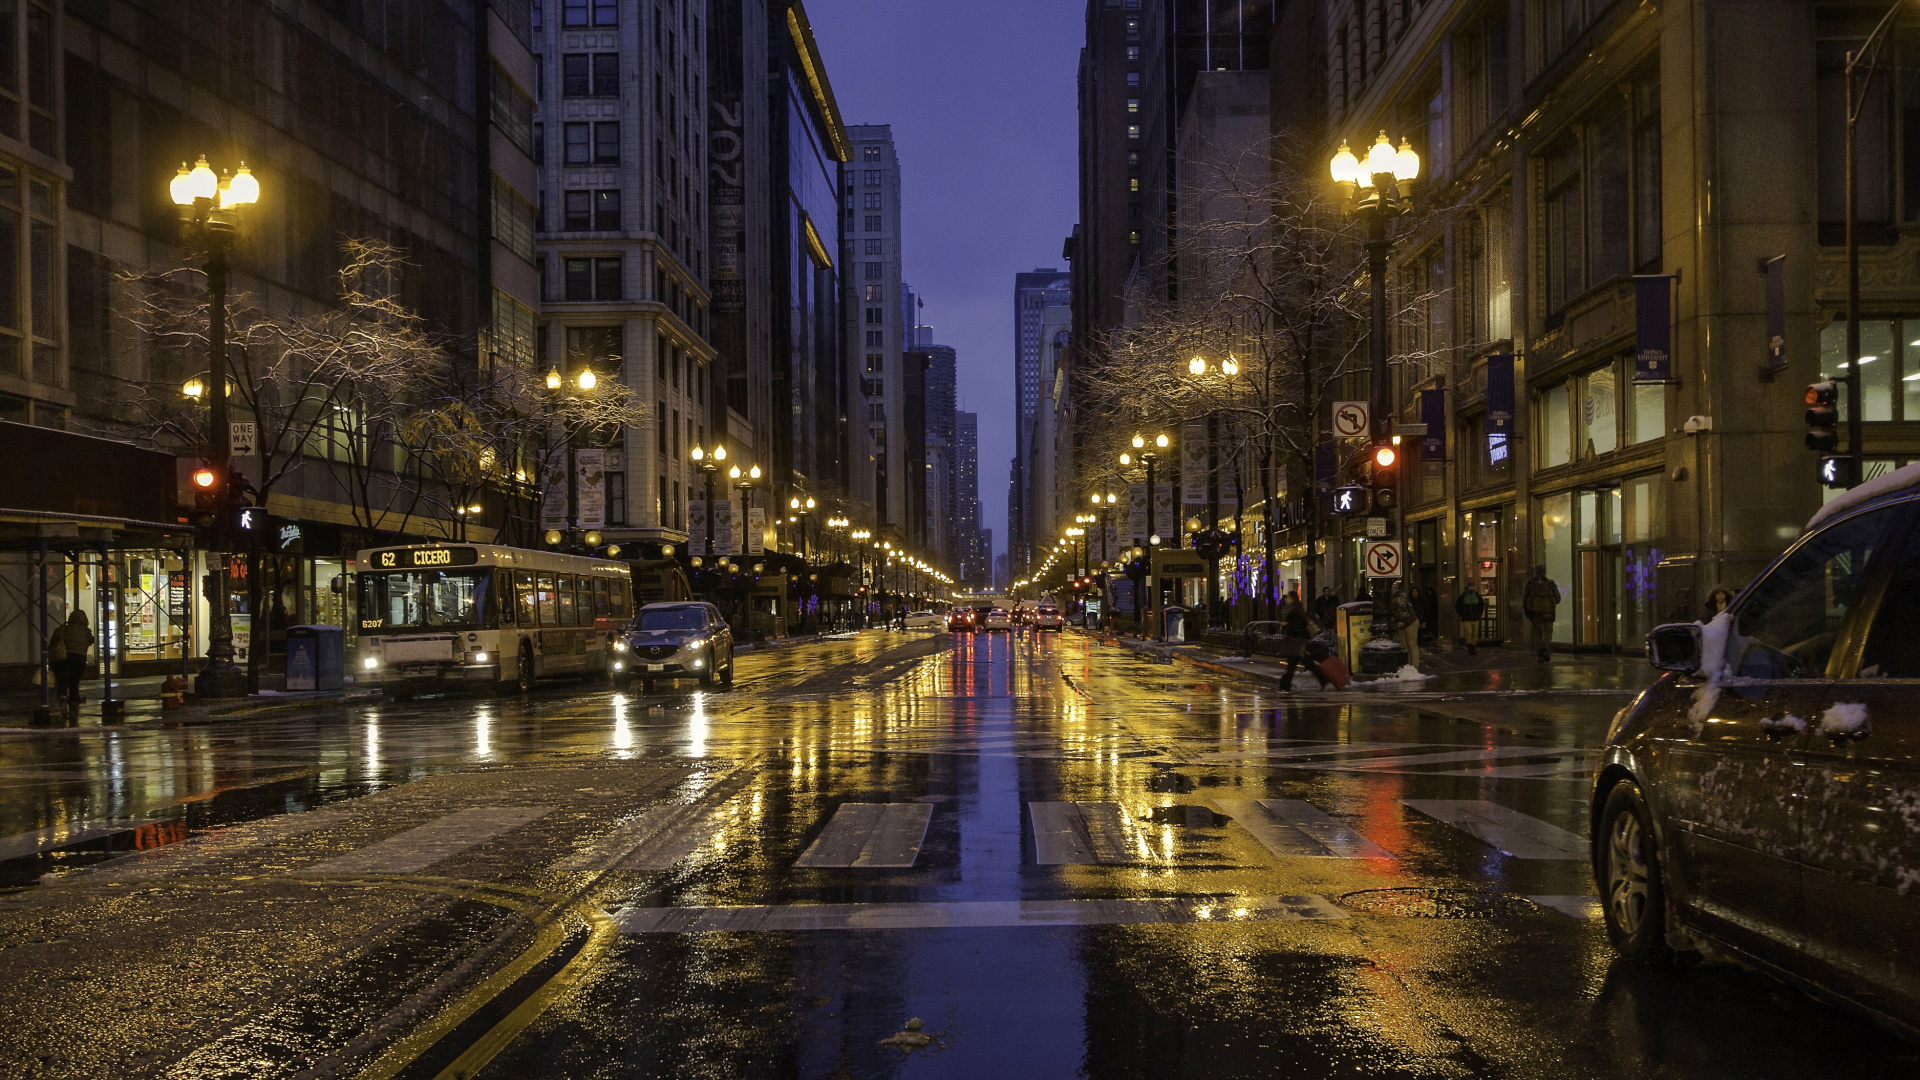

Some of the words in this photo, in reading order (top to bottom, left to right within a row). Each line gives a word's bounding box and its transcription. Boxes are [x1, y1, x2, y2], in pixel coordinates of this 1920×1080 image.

[233, 425, 253, 433] ONE
[233, 435, 254, 443] WAY
[381, 552, 396, 567] 62
[413, 549, 451, 565] CICERO
[362, 618, 383, 629] 6207
